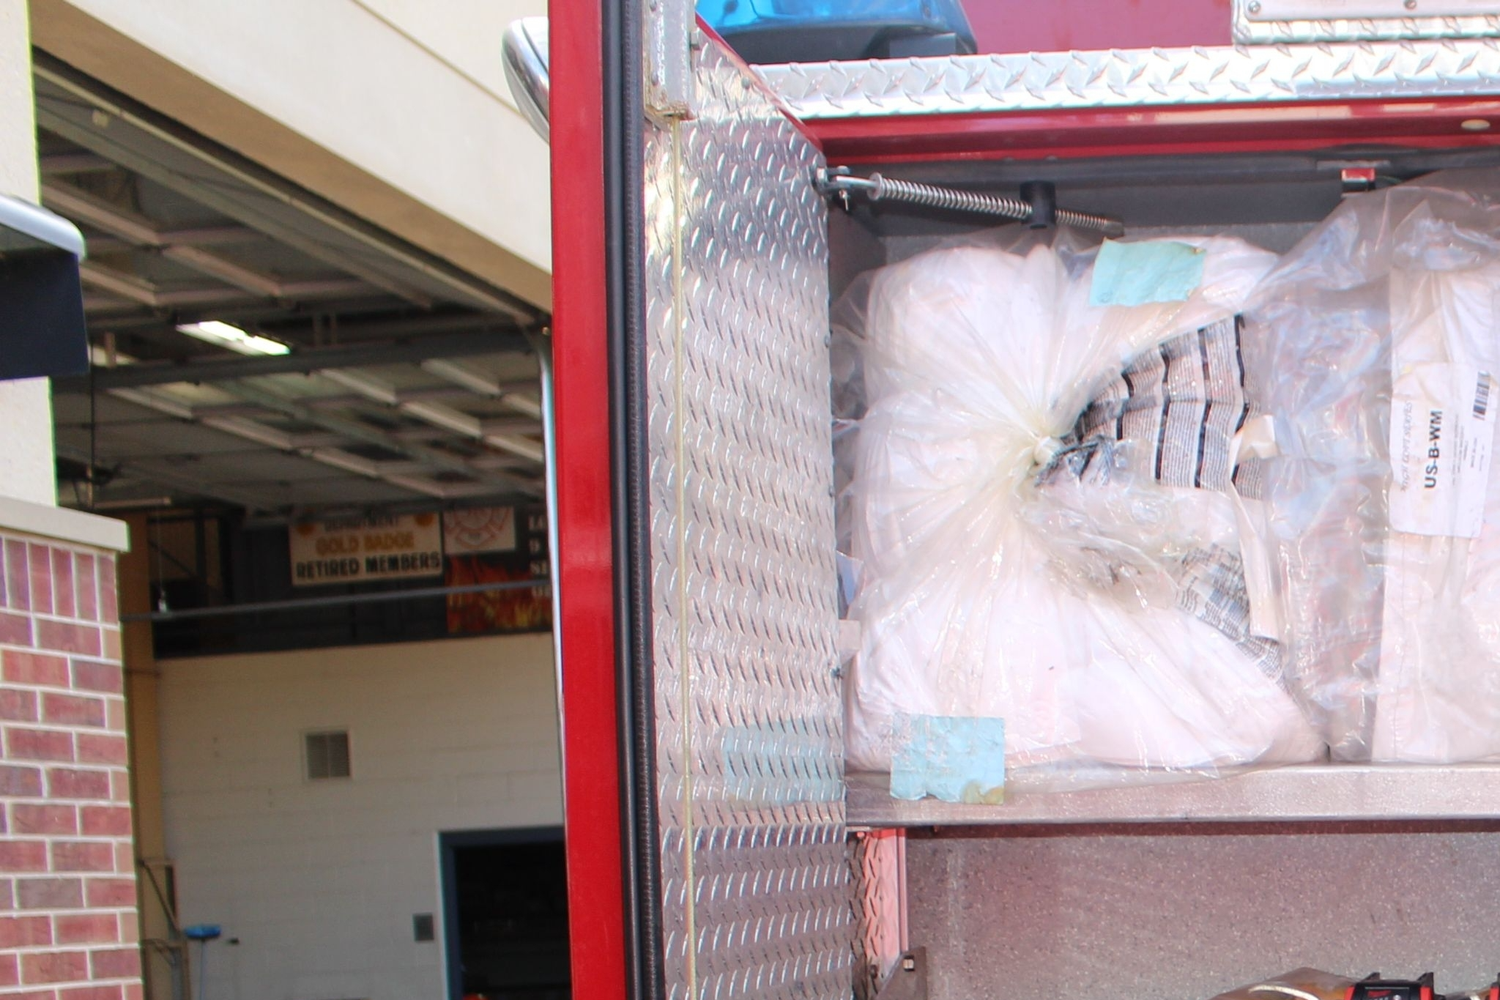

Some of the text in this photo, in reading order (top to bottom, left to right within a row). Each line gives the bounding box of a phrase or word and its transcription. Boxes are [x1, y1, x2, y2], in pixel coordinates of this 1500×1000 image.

[1424, 410, 1443, 489] US-B-WM
[315, 531, 415, 556] GOLD BADGE
[296, 552, 440, 579] RETIRED MEMBERS
